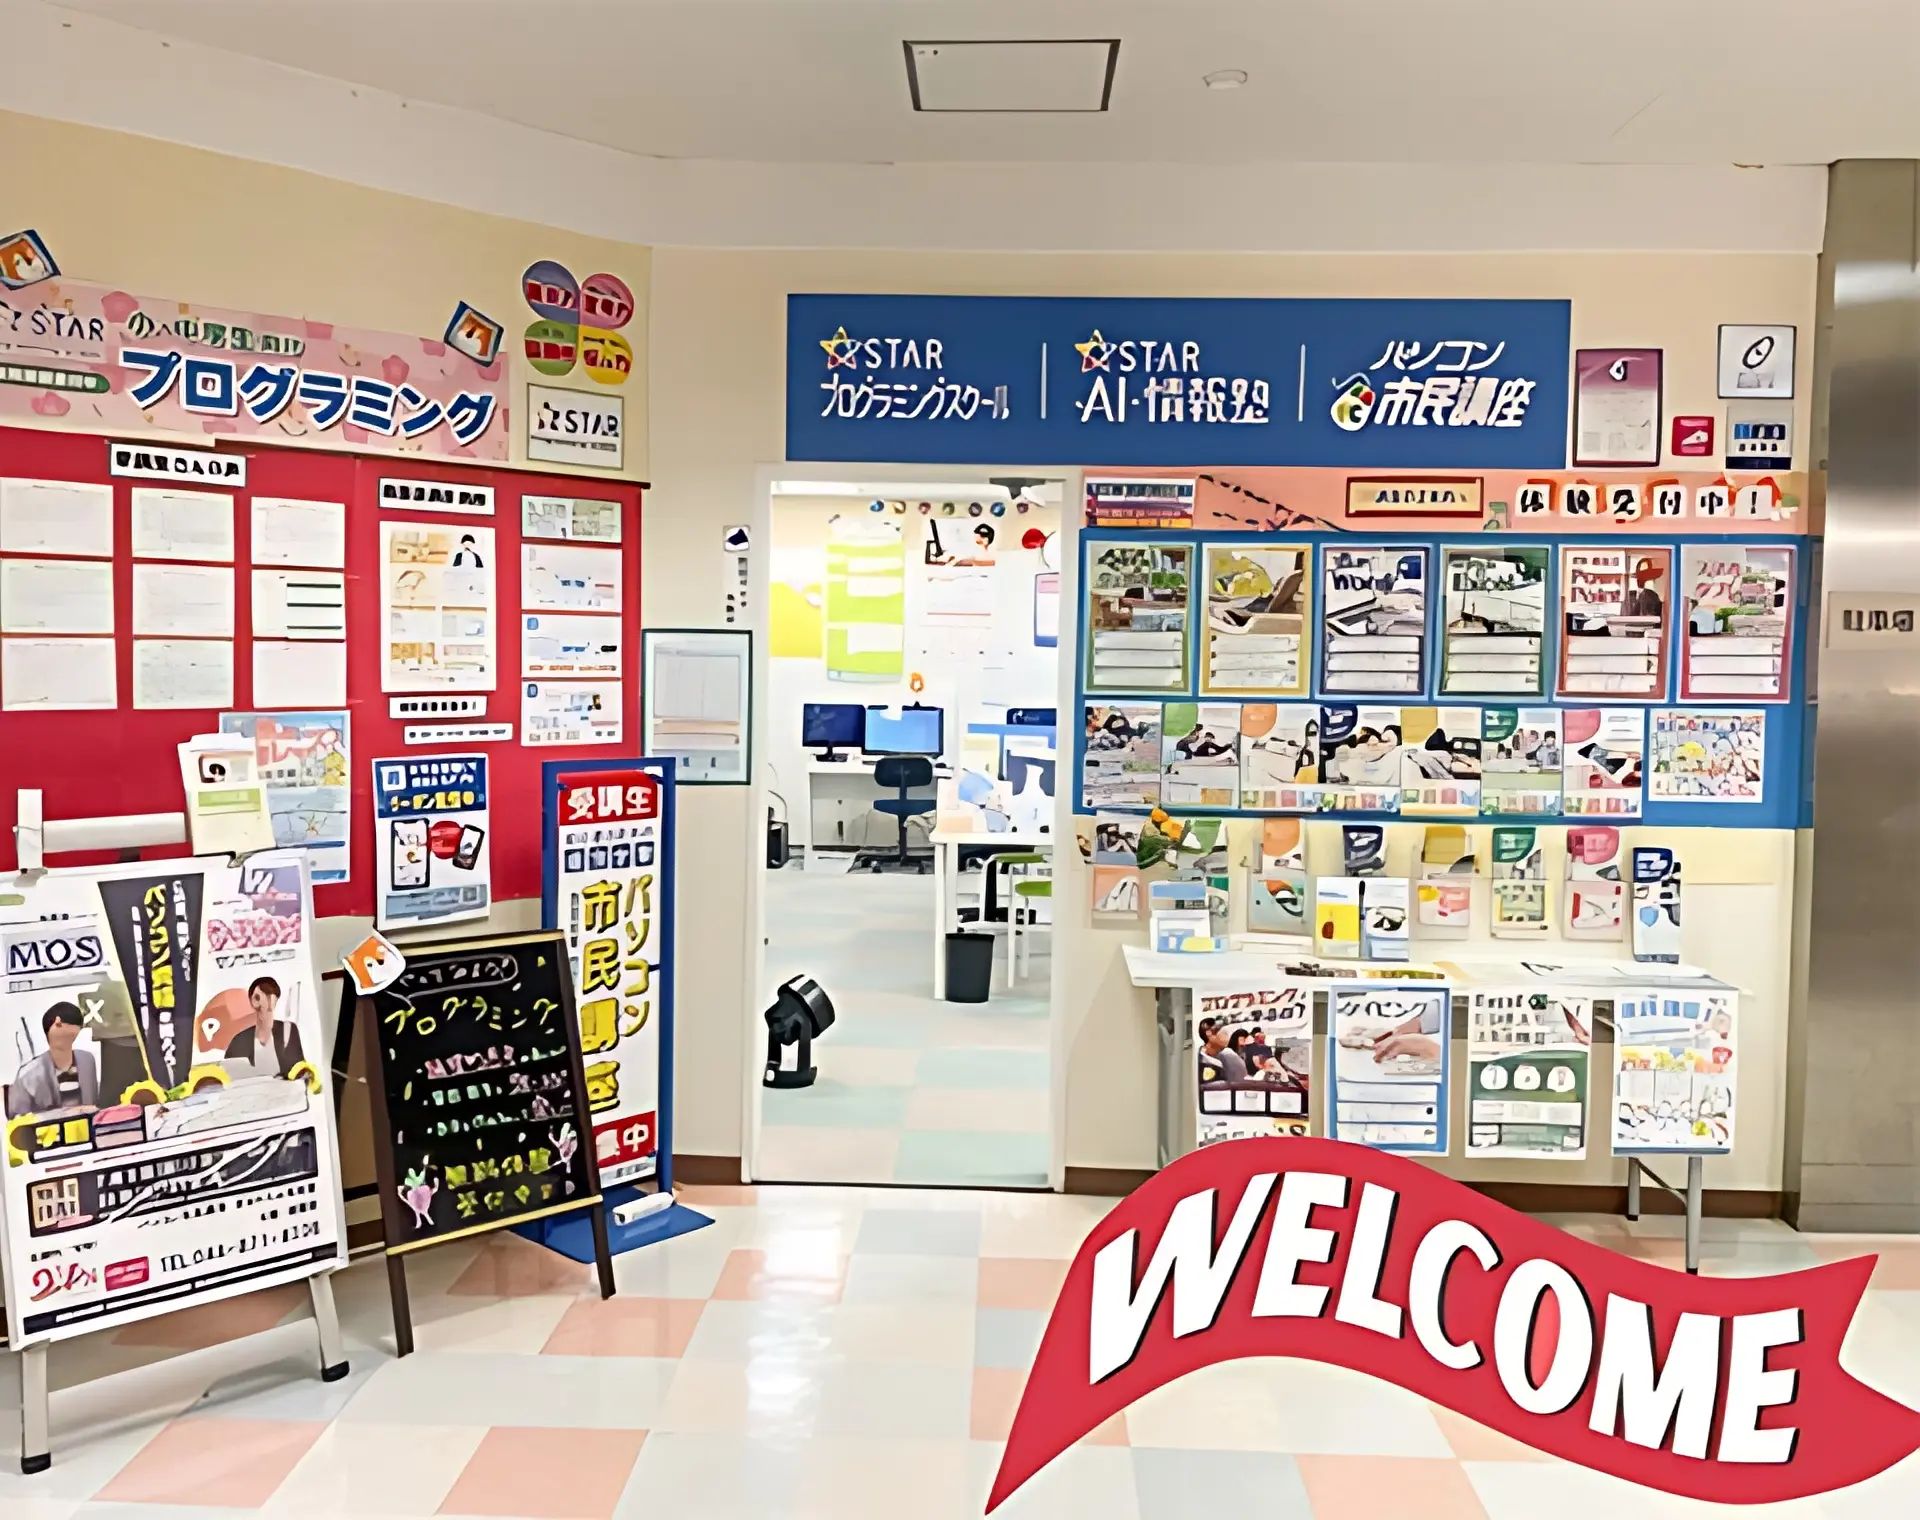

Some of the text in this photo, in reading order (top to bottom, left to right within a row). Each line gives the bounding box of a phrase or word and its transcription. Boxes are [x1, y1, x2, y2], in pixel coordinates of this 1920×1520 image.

[864, 338, 944, 370] STAR
[1118, 340, 1200, 373] STAR
[1369, 341, 1506, 371] パソコン
[119, 347, 497, 447] プログラミング
[10, 936, 98, 969] MOS
